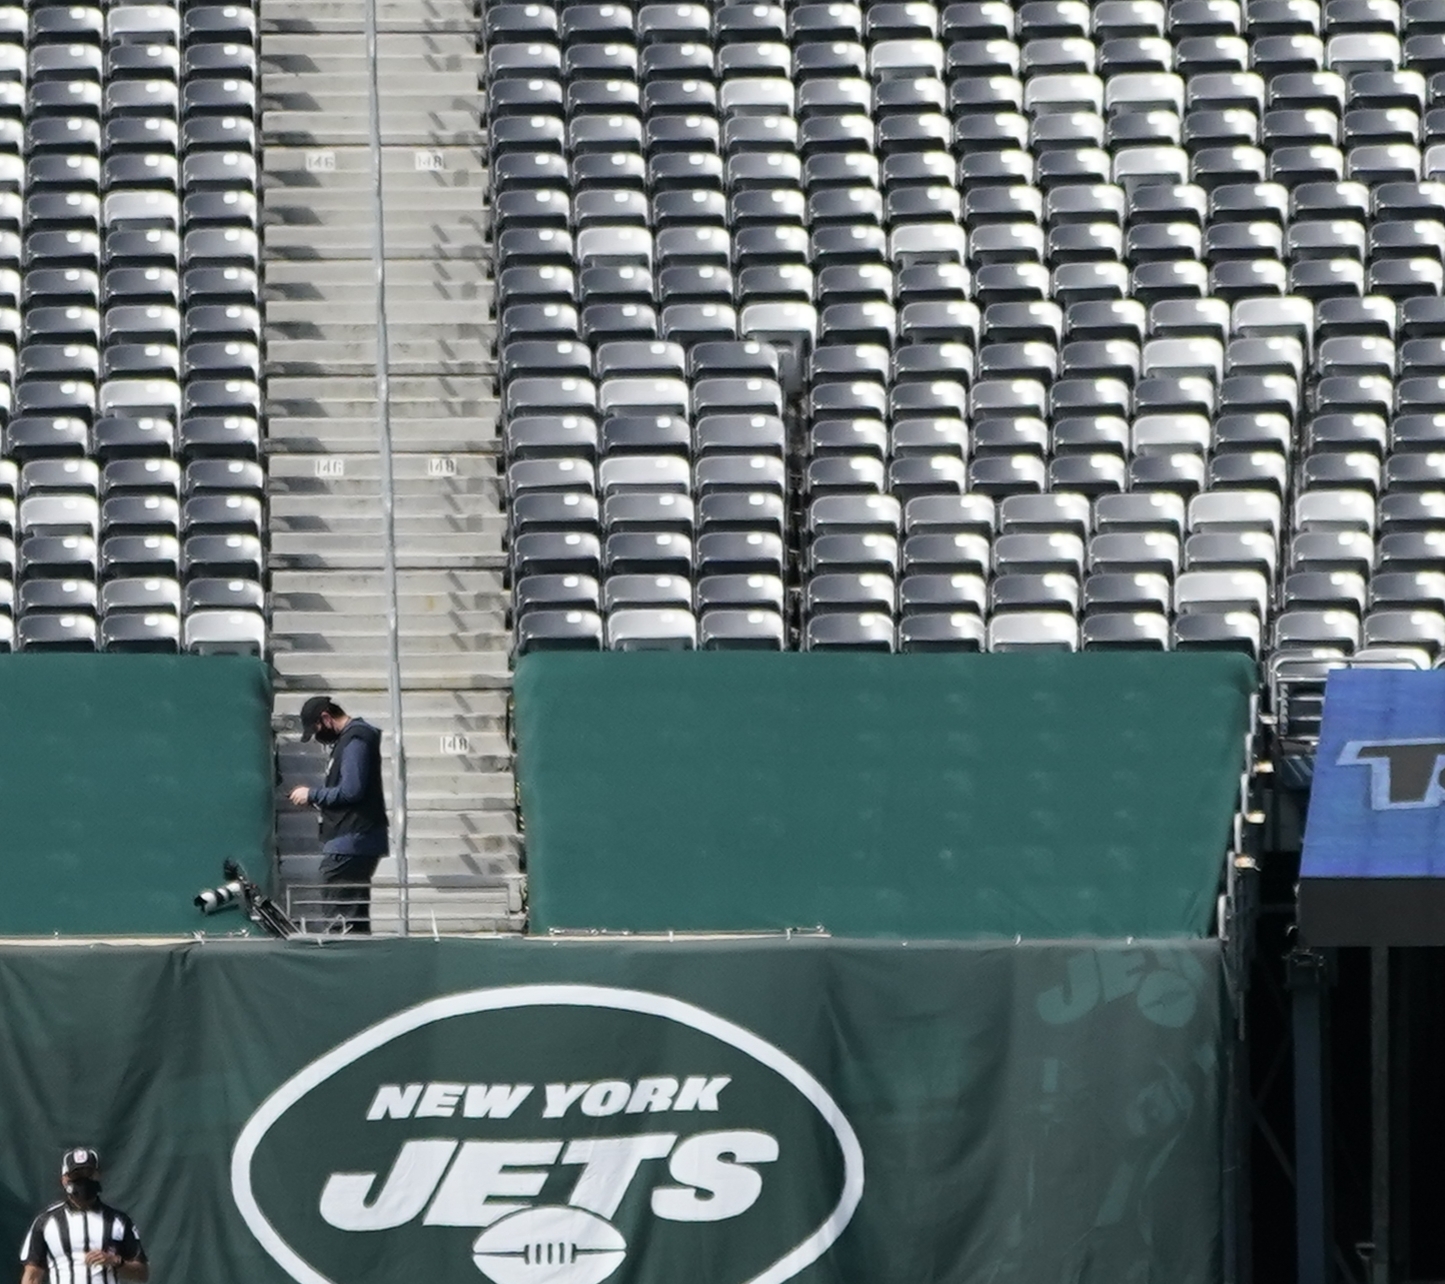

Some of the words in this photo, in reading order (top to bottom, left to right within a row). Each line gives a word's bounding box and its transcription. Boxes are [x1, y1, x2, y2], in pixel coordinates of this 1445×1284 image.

[367, 1081, 542, 1122] NEW
[540, 1075, 732, 1118] YORK
[318, 1129, 781, 1233] JETS
